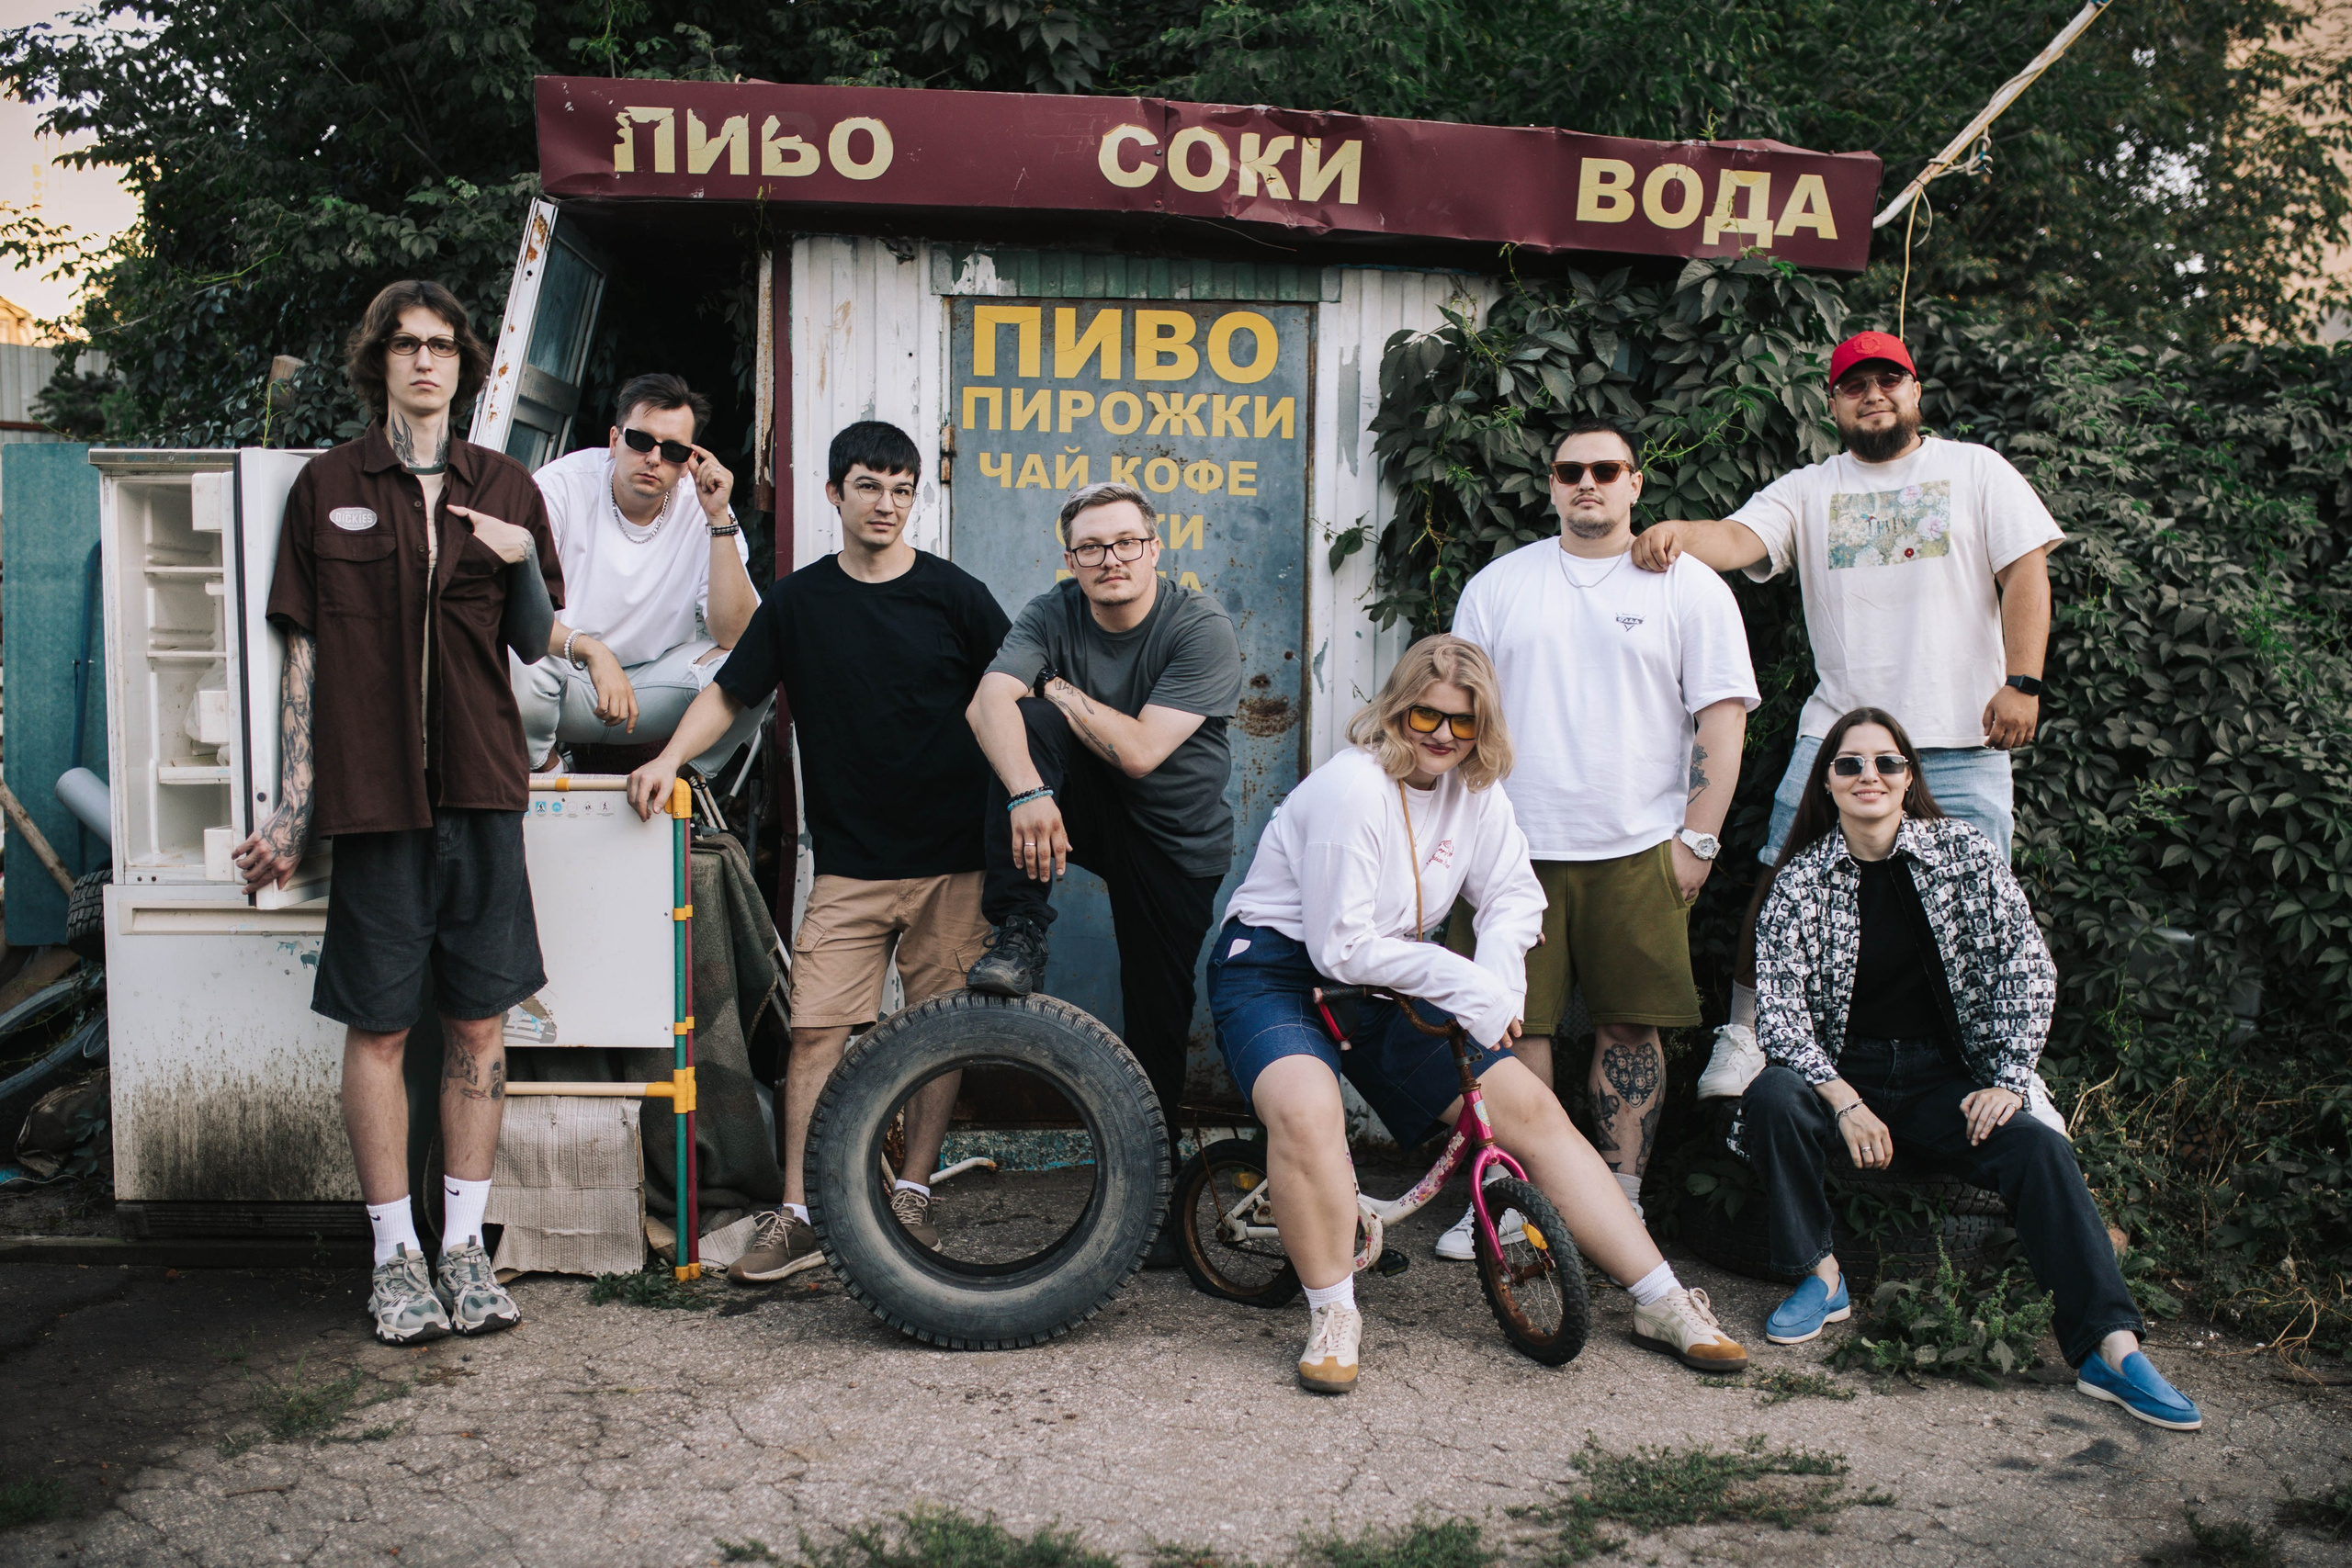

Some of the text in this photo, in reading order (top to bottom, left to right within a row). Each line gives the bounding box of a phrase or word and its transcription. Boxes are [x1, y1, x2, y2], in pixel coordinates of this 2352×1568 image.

[1098, 123, 1363, 205] СОКИ
[1576, 157, 1838, 248] ВОДА
[973, 305, 1279, 384] ПИВО
[962, 386, 1295, 439] ПИРОЖКИ
[979, 446, 1258, 496] ЧАЙ КОФЕ
[335, 512, 373, 524] DICKIES
